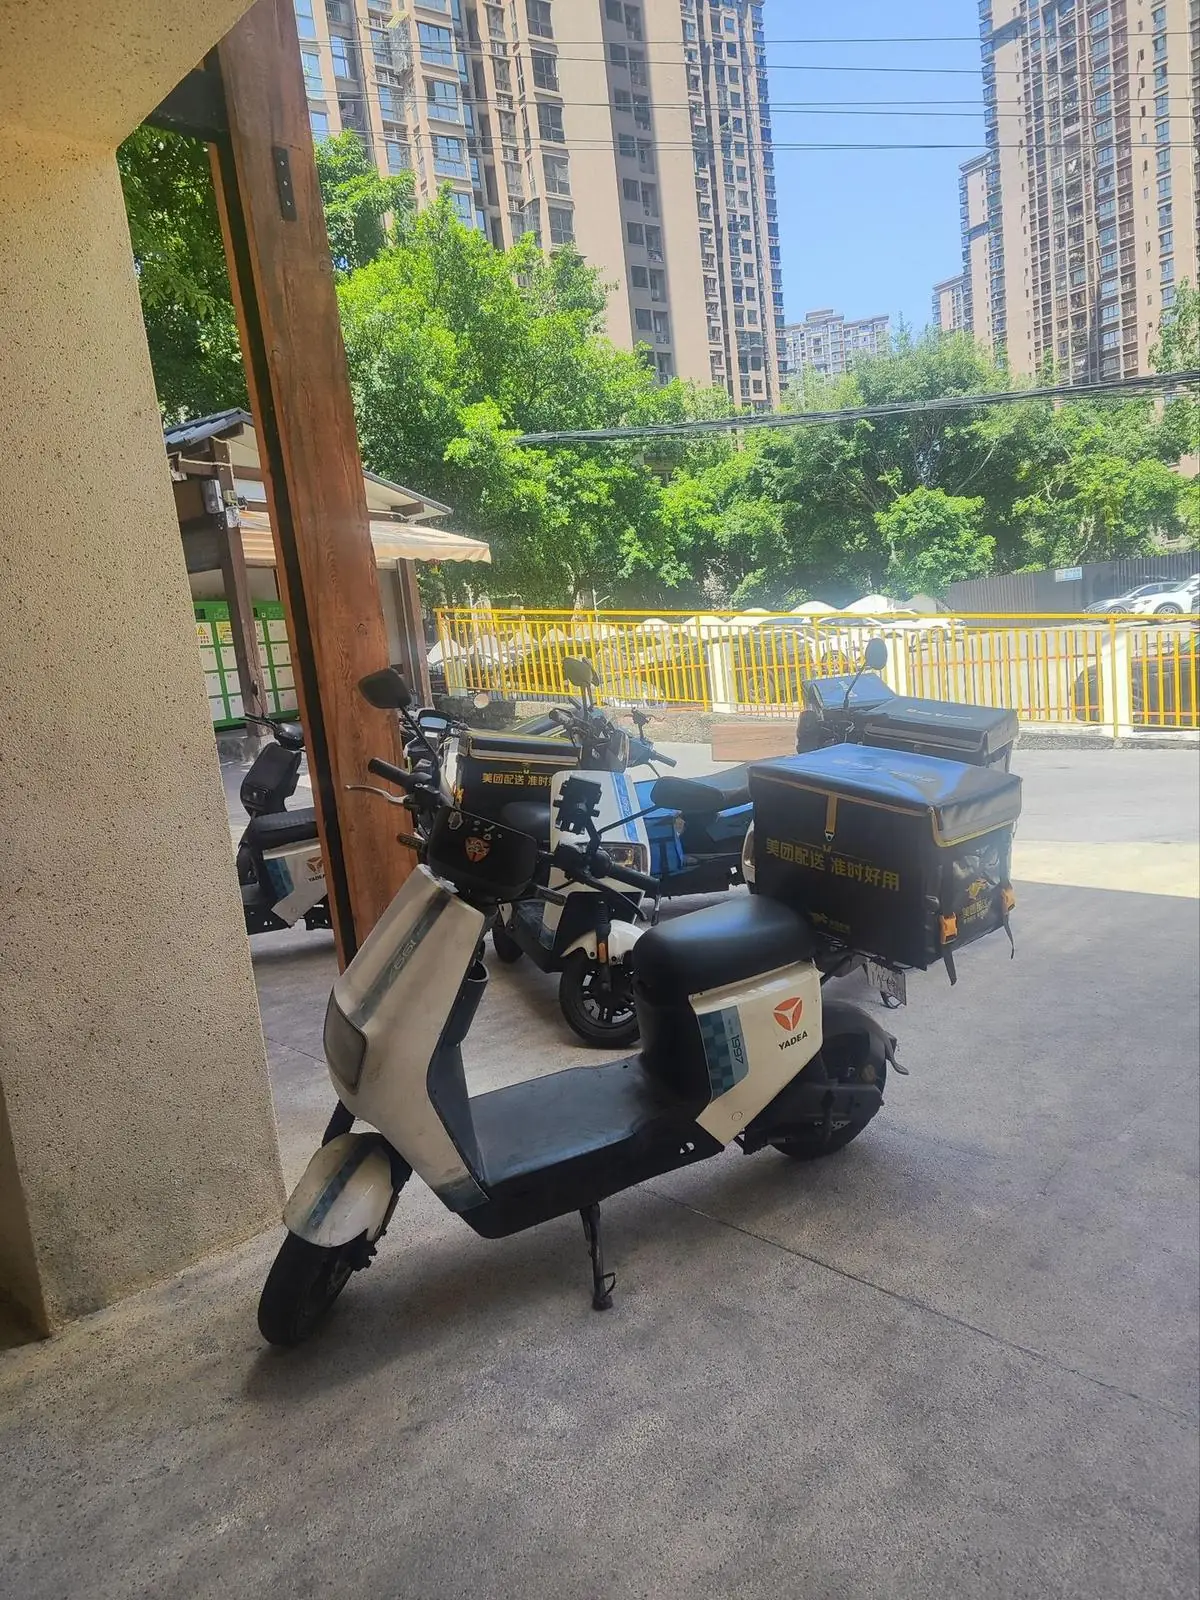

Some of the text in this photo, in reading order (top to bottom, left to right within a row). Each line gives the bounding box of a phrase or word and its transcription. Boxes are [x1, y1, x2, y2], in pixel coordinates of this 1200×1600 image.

[482, 772, 525, 786] 美团配送
[766, 838, 900, 891] 美团配送 准时好用
[778, 1030, 808, 1050] YADEA
